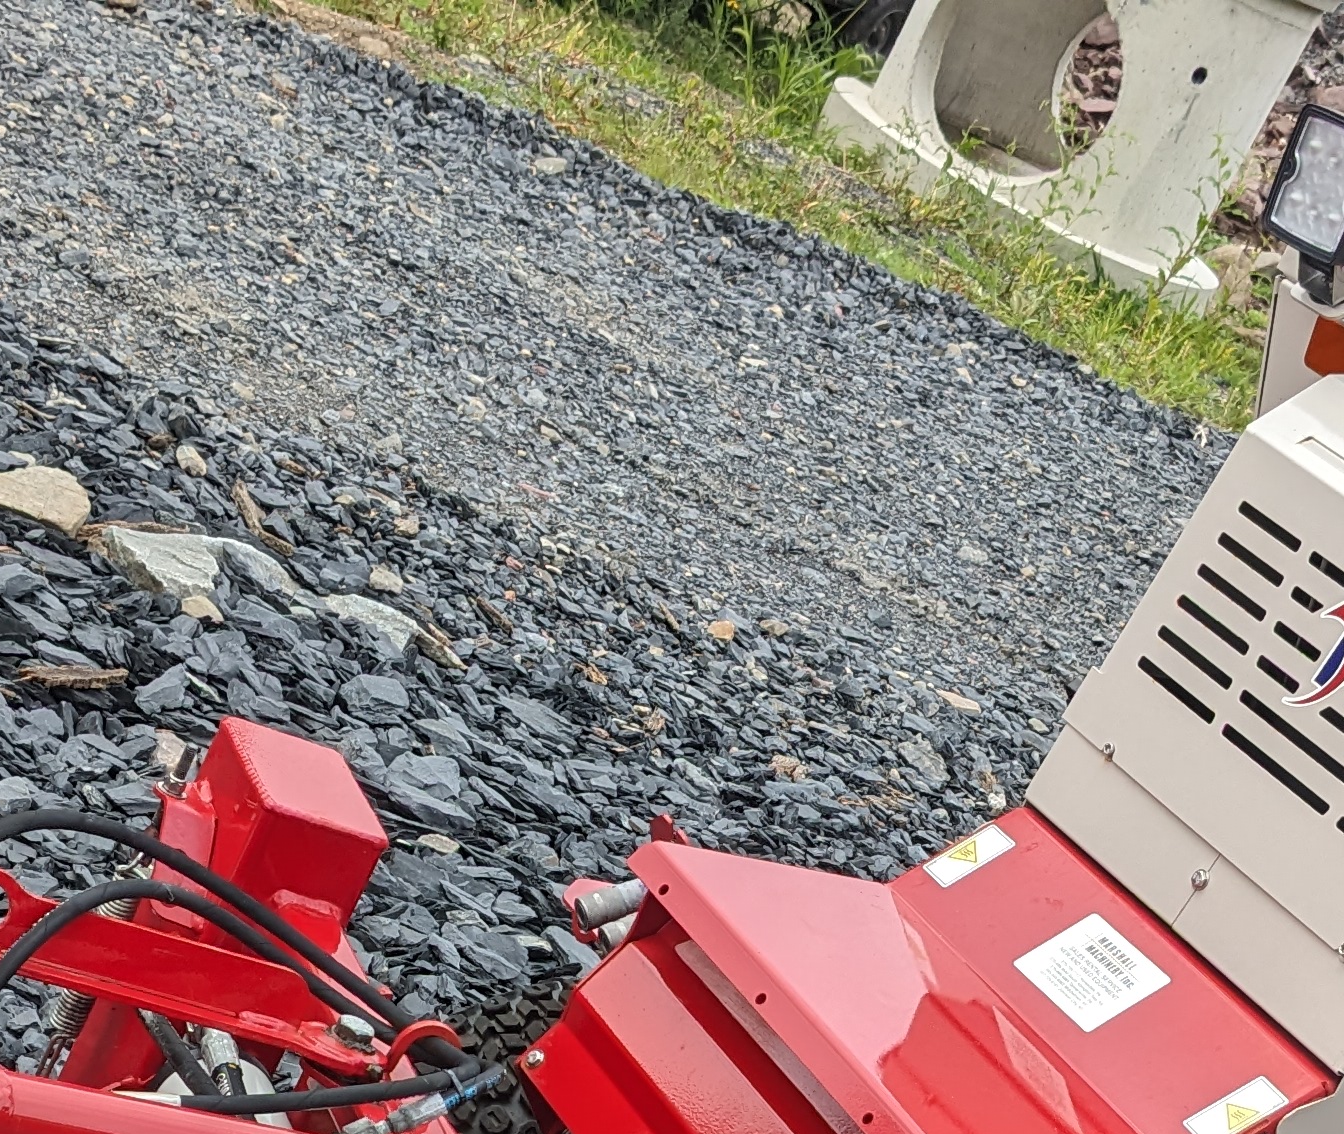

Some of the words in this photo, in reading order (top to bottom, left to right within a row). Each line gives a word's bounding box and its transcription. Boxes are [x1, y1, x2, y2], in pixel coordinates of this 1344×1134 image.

[1068, 945, 1085, 962] SALES
[1084, 959, 1102, 977] RENTAL
[1100, 974, 1123, 994] SERVICE
[1084, 944, 1124, 979] MACHINERY
[1097, 936, 1138, 971] MARSHALL
[1070, 955, 1082, 968] AND
[1092, 976, 1120, 1001] EQUIPMENT
